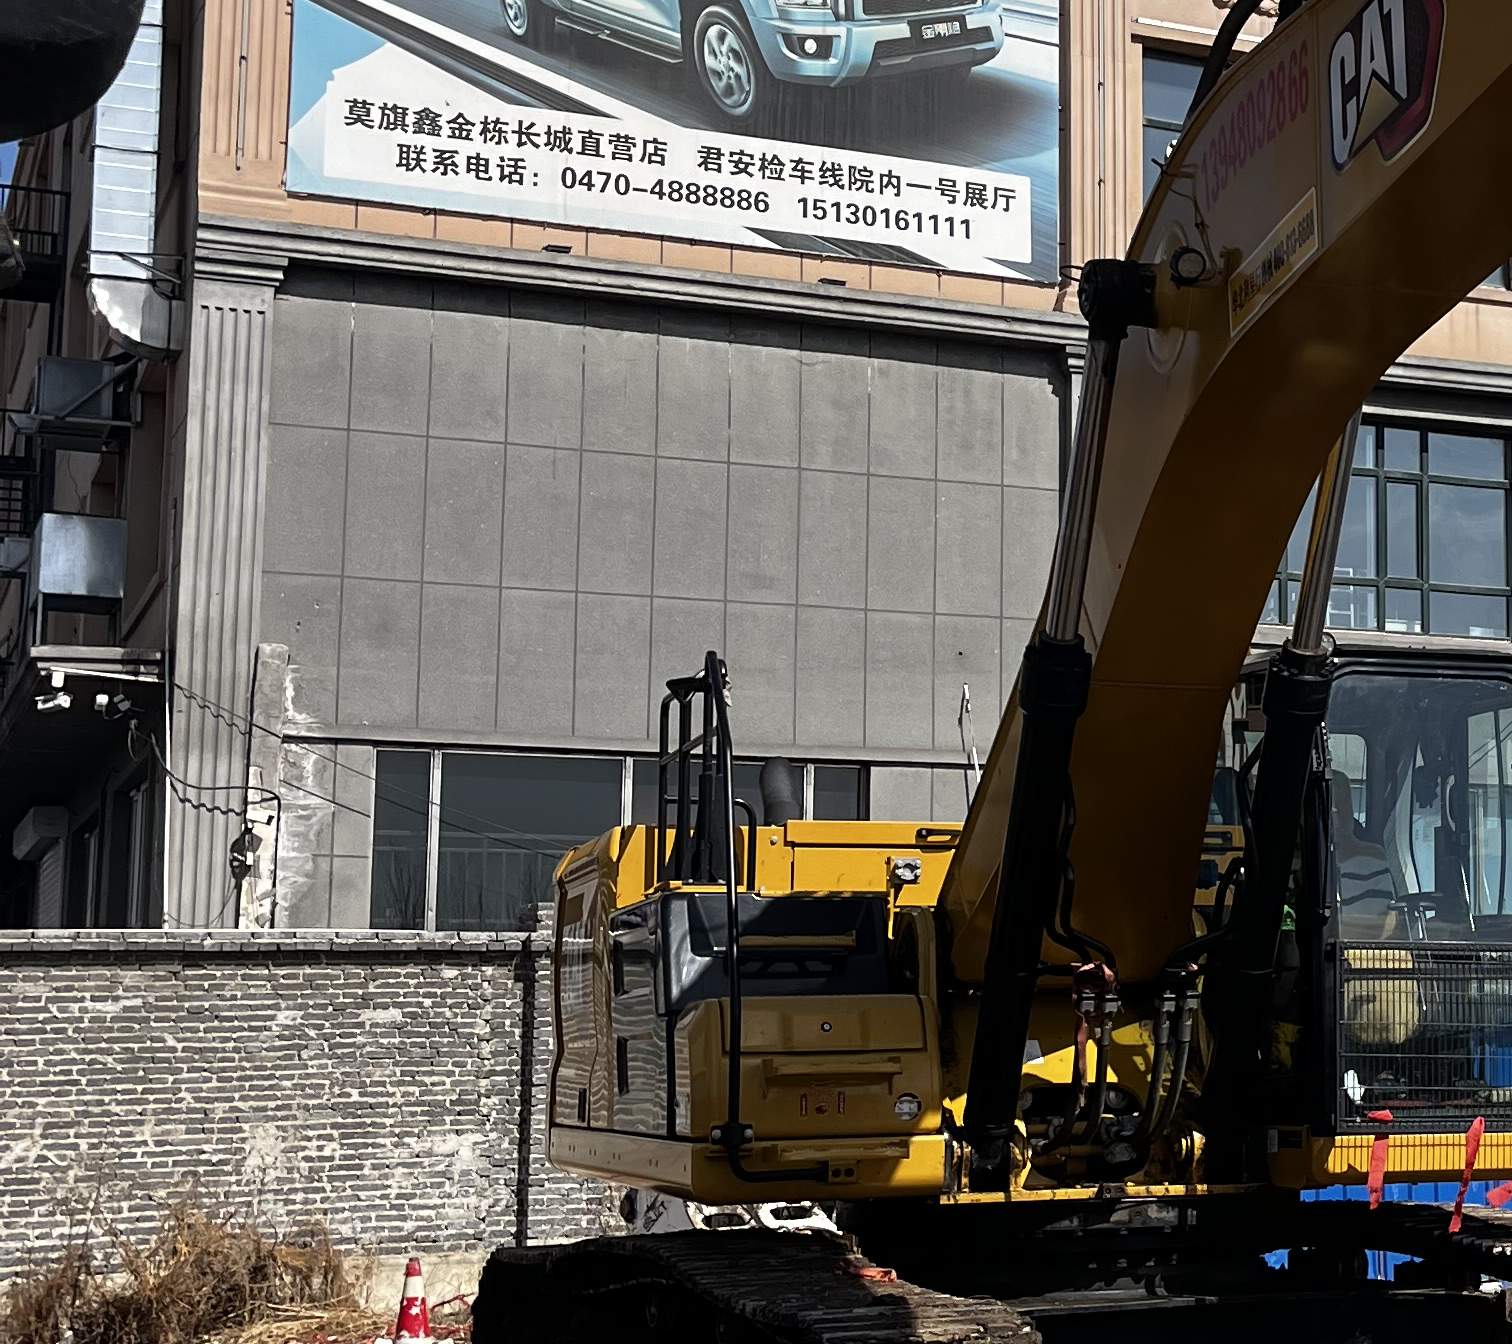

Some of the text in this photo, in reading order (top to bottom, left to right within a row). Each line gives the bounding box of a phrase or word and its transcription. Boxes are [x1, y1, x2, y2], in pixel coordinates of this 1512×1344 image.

[343, 97, 1017, 213] 莫旗鑫金栋长城直营店 君安检车线院内一号展厅
[797, 196, 971, 240] 15130161111
